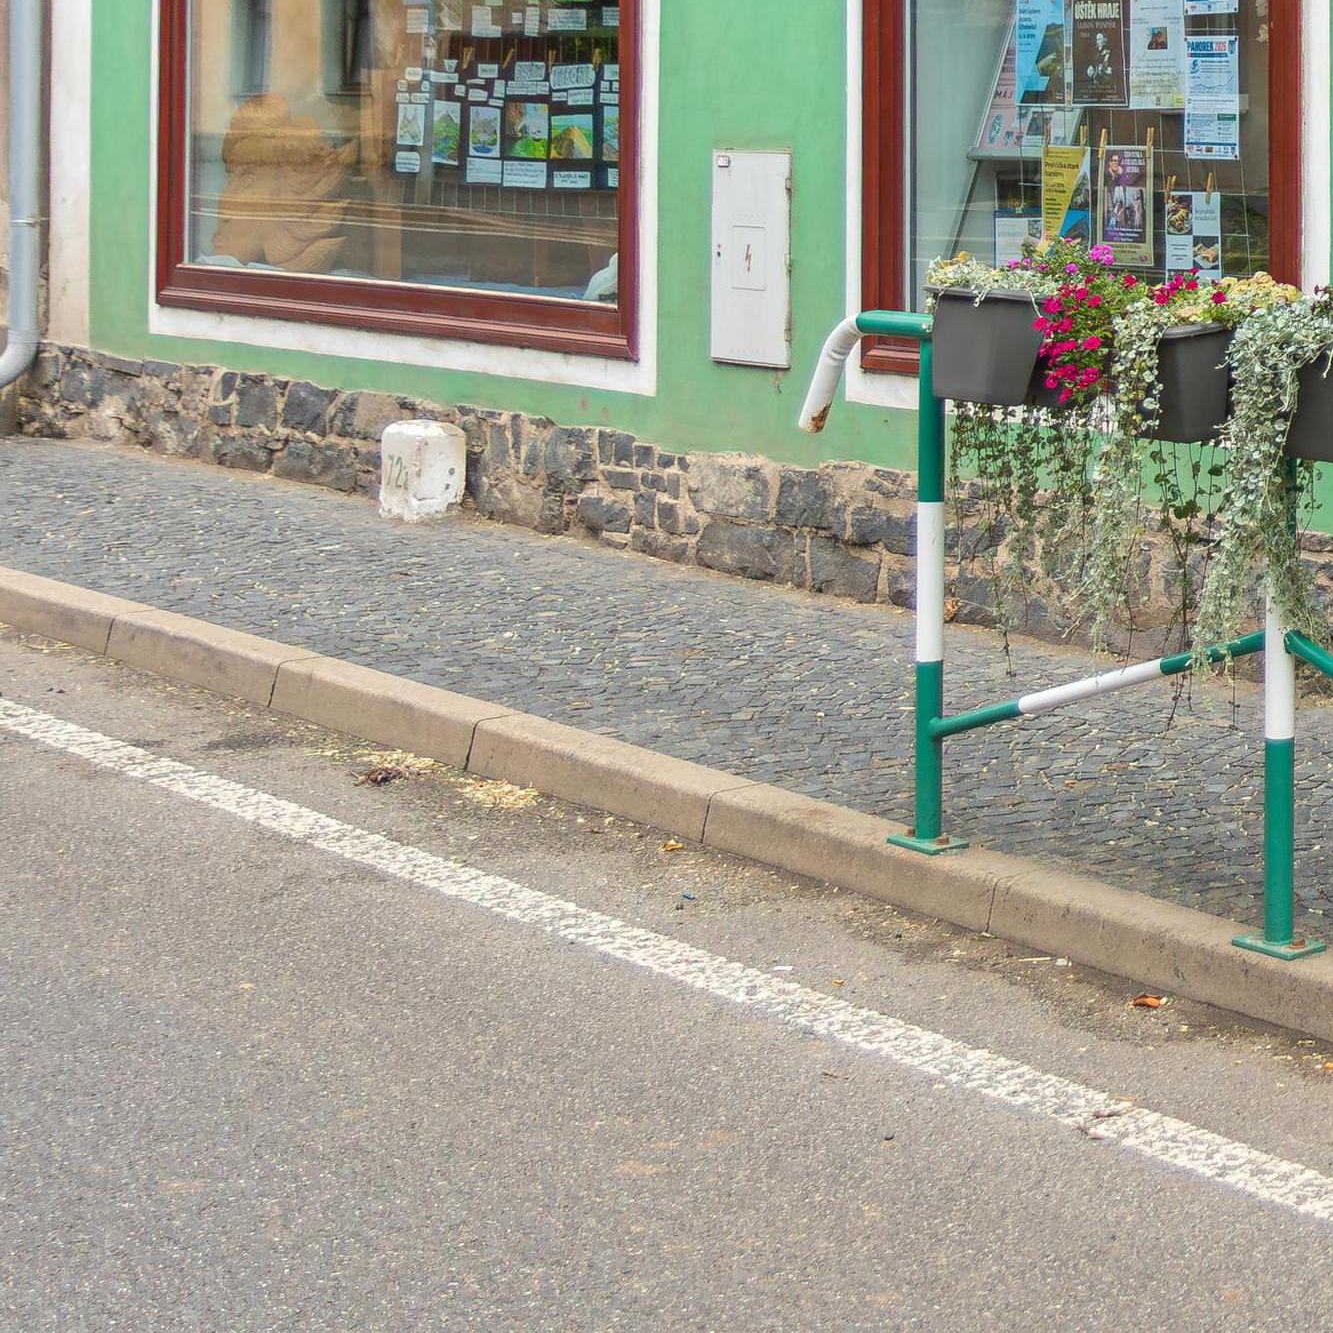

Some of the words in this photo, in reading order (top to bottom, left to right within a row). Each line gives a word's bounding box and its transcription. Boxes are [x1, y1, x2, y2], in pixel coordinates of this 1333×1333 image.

[1074, 0, 1097, 20] ÚŠTĚK
[1097, 2, 1120, 19] HRAJE
[1187, 41, 1214, 52] PAHOREK
